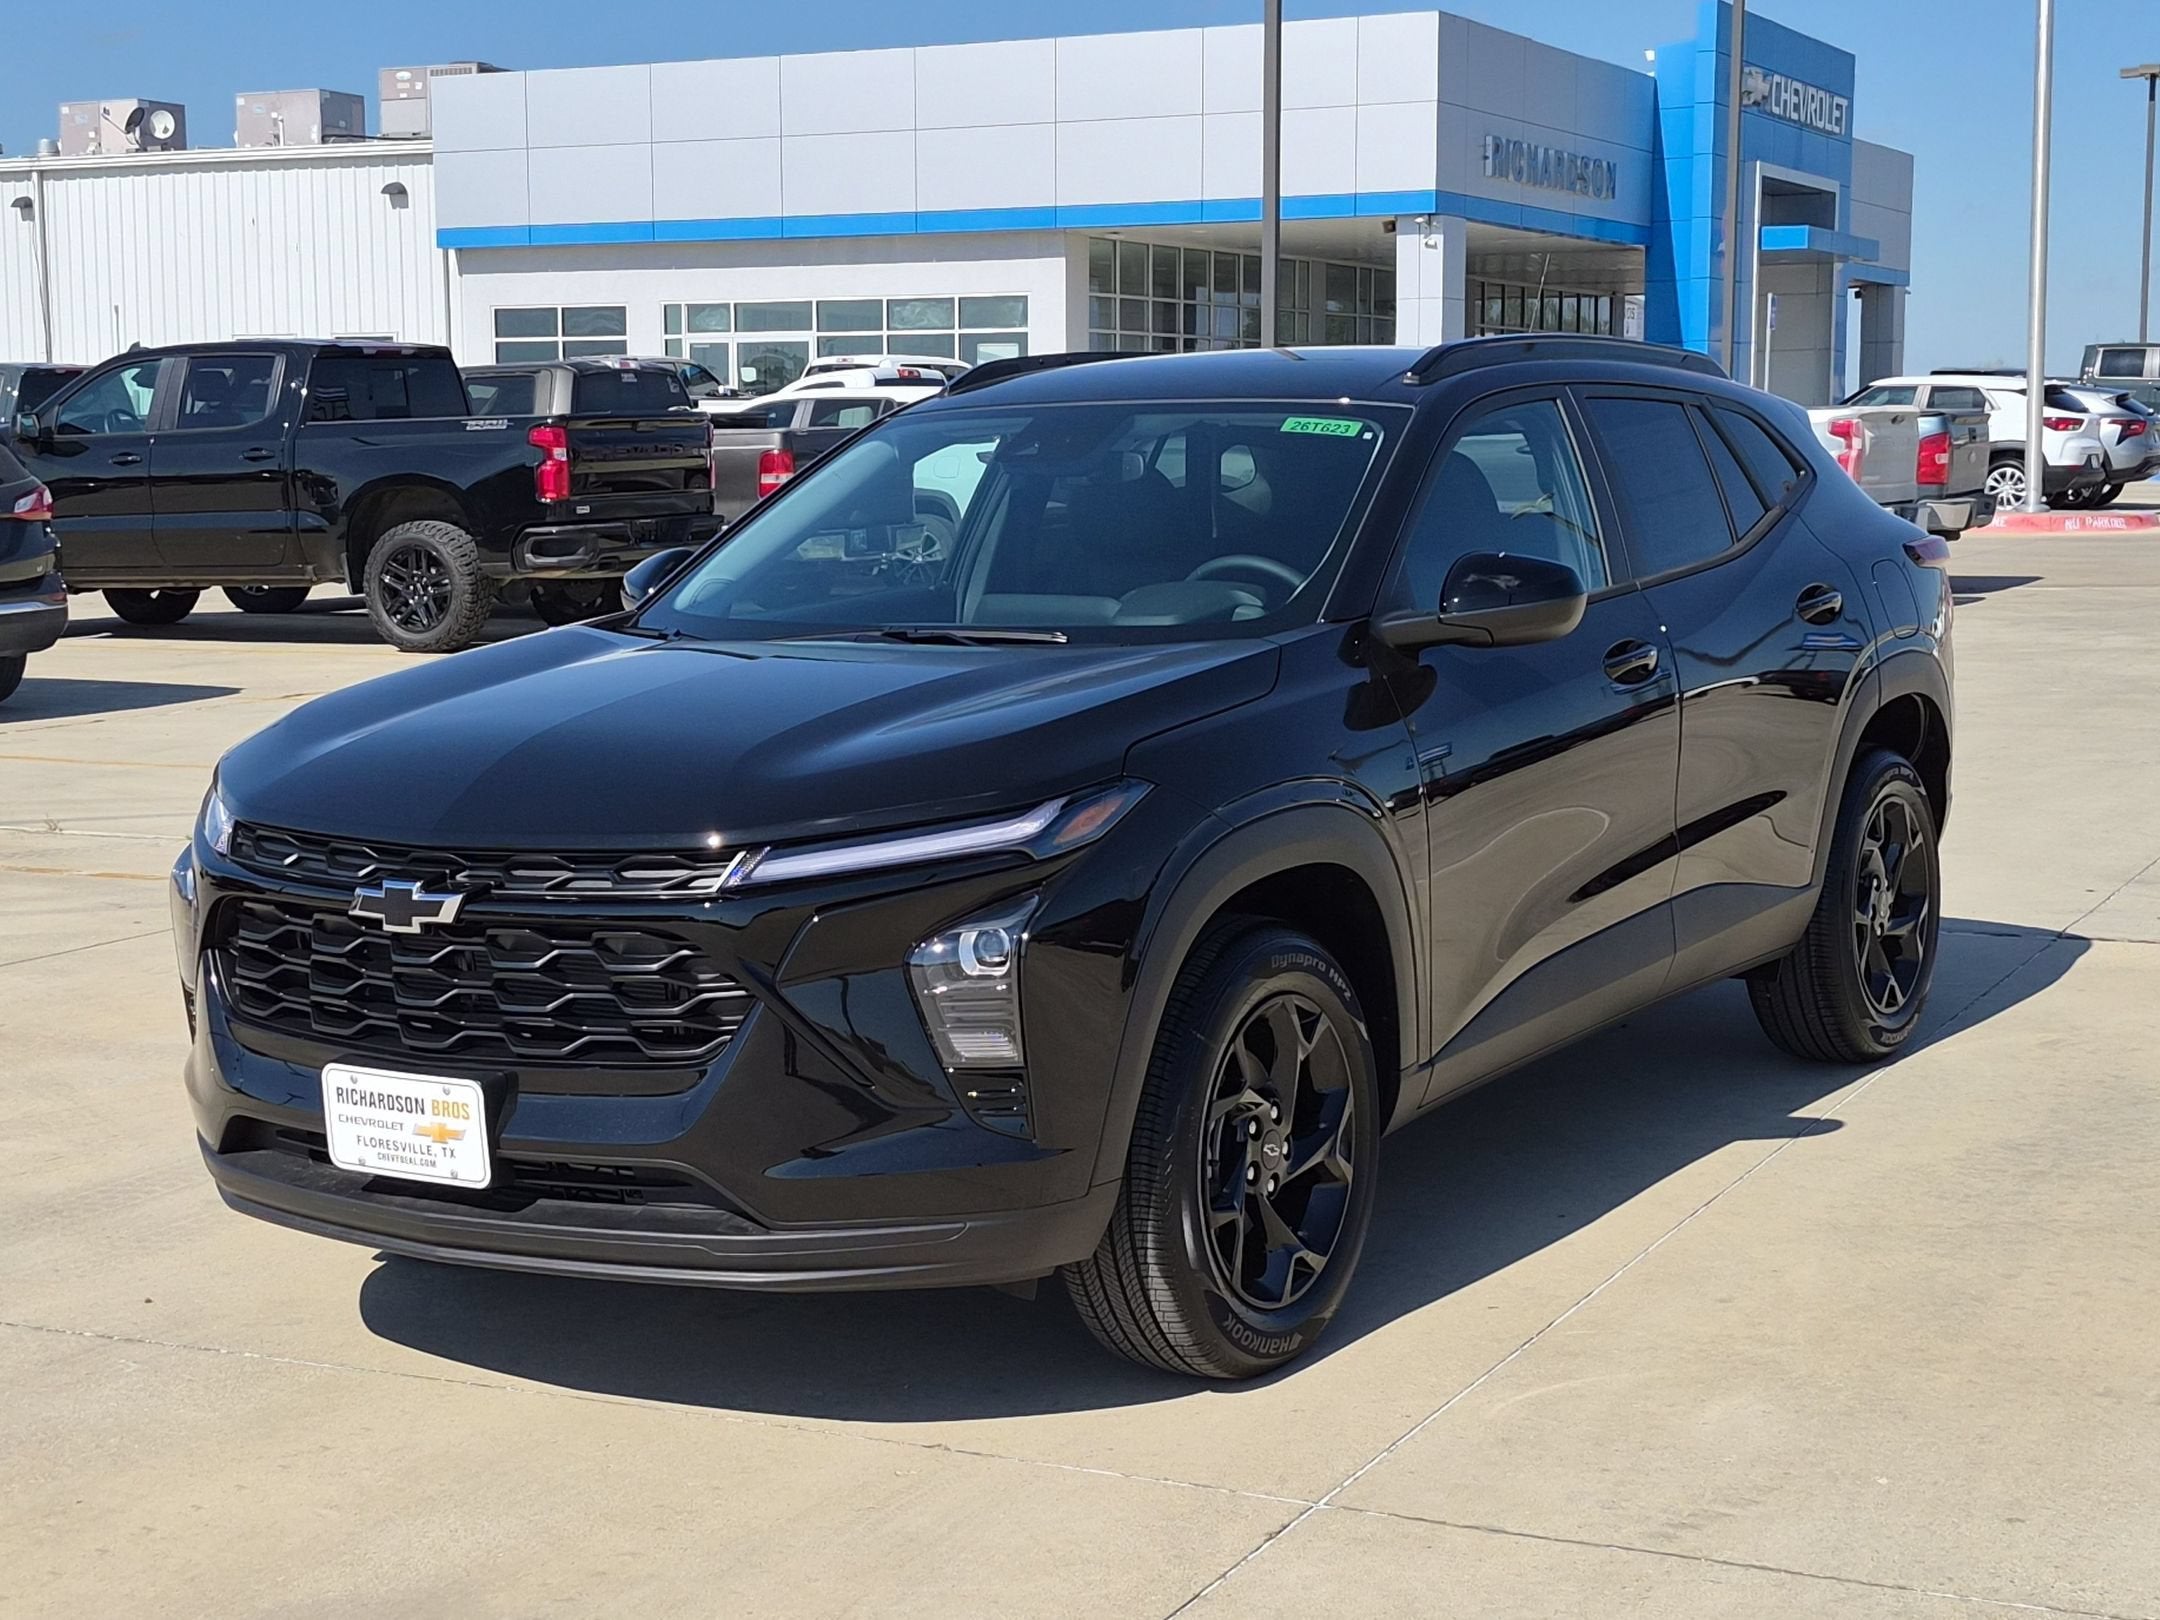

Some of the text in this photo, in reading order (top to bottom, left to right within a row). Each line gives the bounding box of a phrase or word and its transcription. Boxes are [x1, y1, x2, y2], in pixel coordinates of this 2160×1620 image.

[1772, 73, 1848, 136] CHEVROLET
[1485, 135, 1617, 199] RICHARDSON
[1290, 421, 1351, 434] 26T623
[1271, 952, 1352, 1002] Dynapro HP2
[336, 1086, 470, 1120] RICHARDSON BROS
[338, 1113, 404, 1131] CHEVROLET
[356, 1135, 456, 1159] FLORESVILLE, TX
